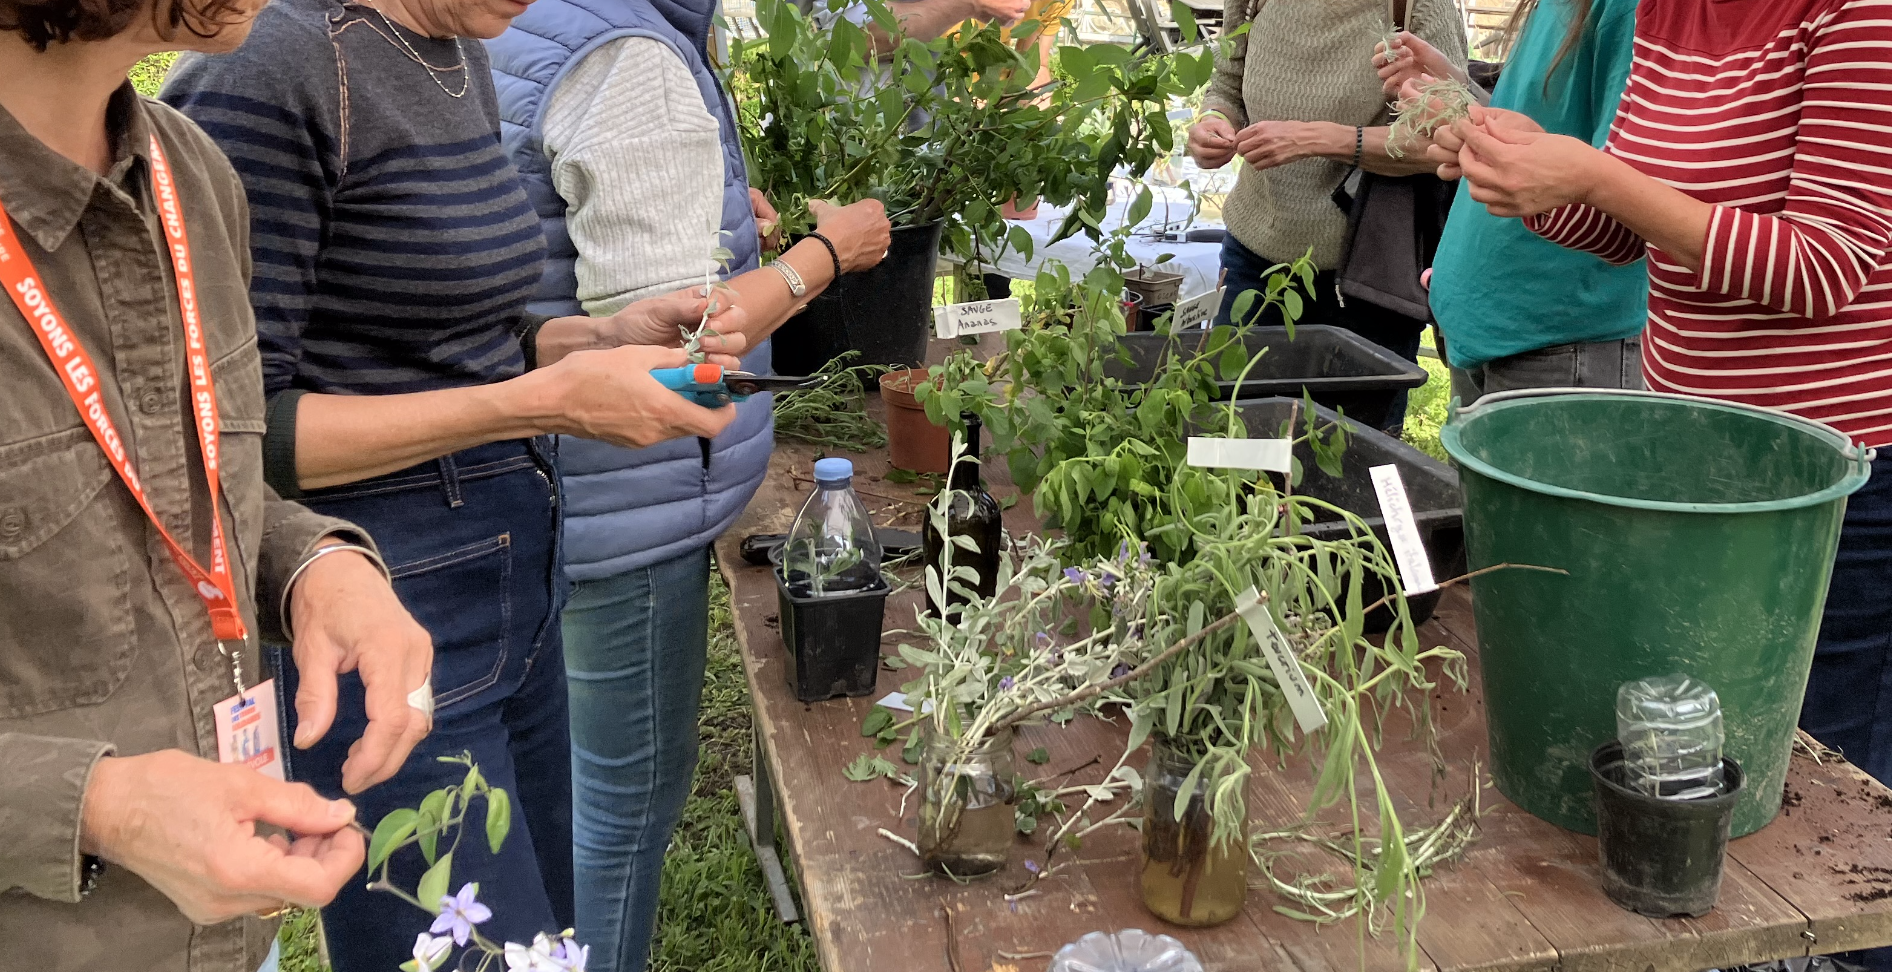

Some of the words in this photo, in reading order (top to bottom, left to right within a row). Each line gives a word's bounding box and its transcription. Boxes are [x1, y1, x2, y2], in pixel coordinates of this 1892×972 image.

[175, 246, 188, 273] DU
[181, 278, 201, 350] FORCES
[957, 317, 998, 331] Ananas
[15, 276, 74, 358] SOYONS
[64, 355, 94, 395] LES
[84, 390, 124, 463] FORCES
[193, 354, 208, 386] LES
[197, 391, 217, 470] SOYONS
